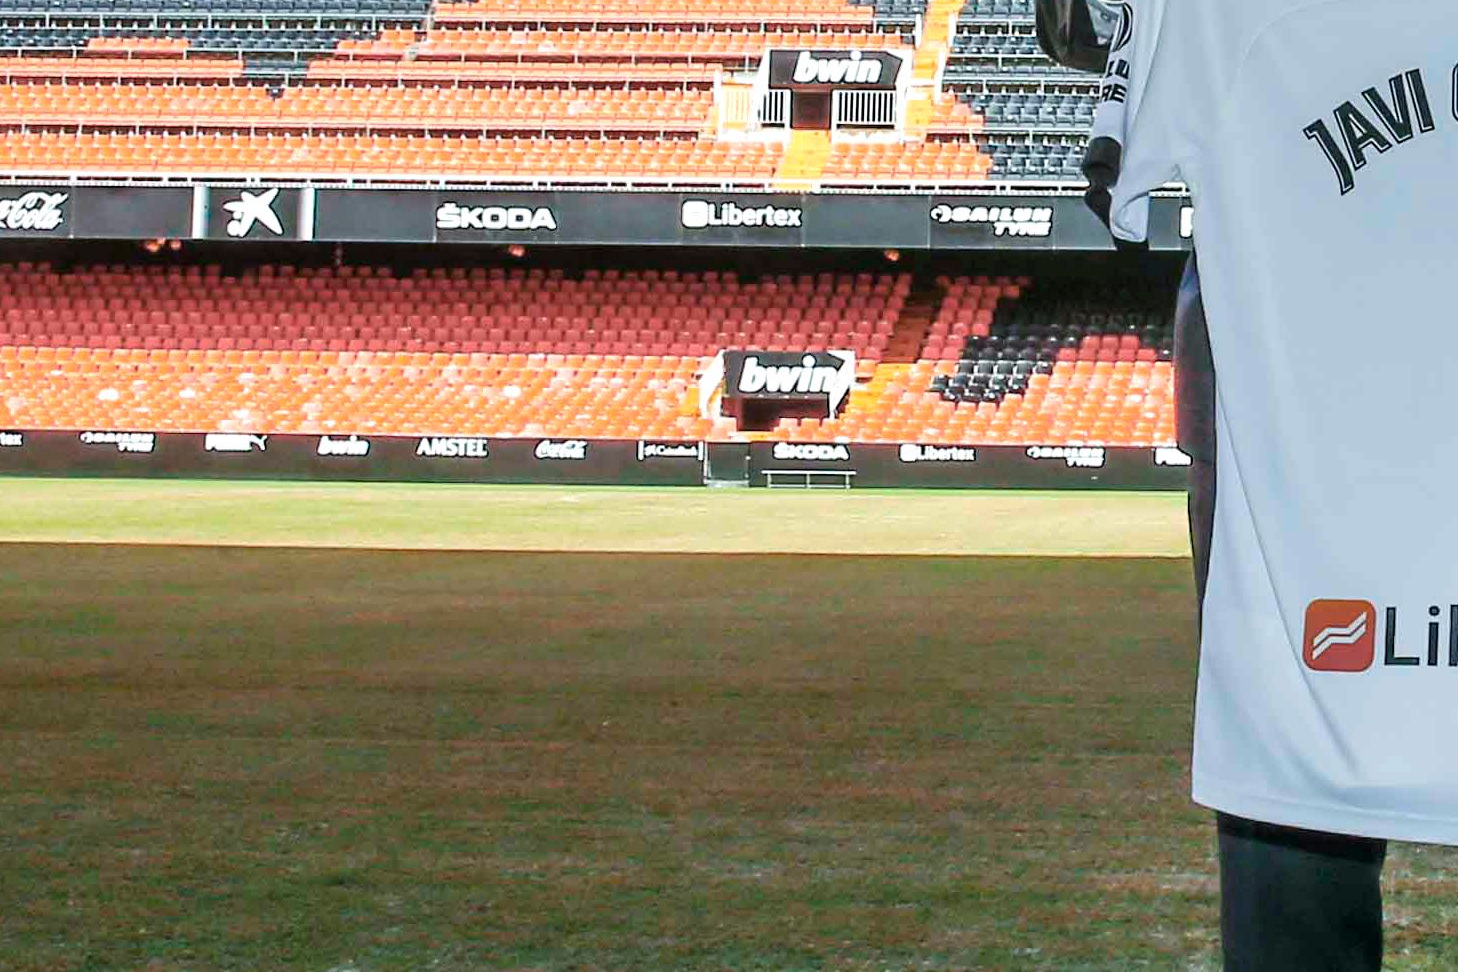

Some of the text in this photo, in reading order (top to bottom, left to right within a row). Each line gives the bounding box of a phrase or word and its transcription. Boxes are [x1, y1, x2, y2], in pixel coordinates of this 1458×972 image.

[792, 51, 882, 83] bwin
[1303, 68, 1435, 195] JAVI
[436, 202, 557, 230] ŠKODA
[708, 202, 802, 228] Libertex
[738, 355, 842, 393] bwin
[416, 438, 487, 456] AMSTEL
